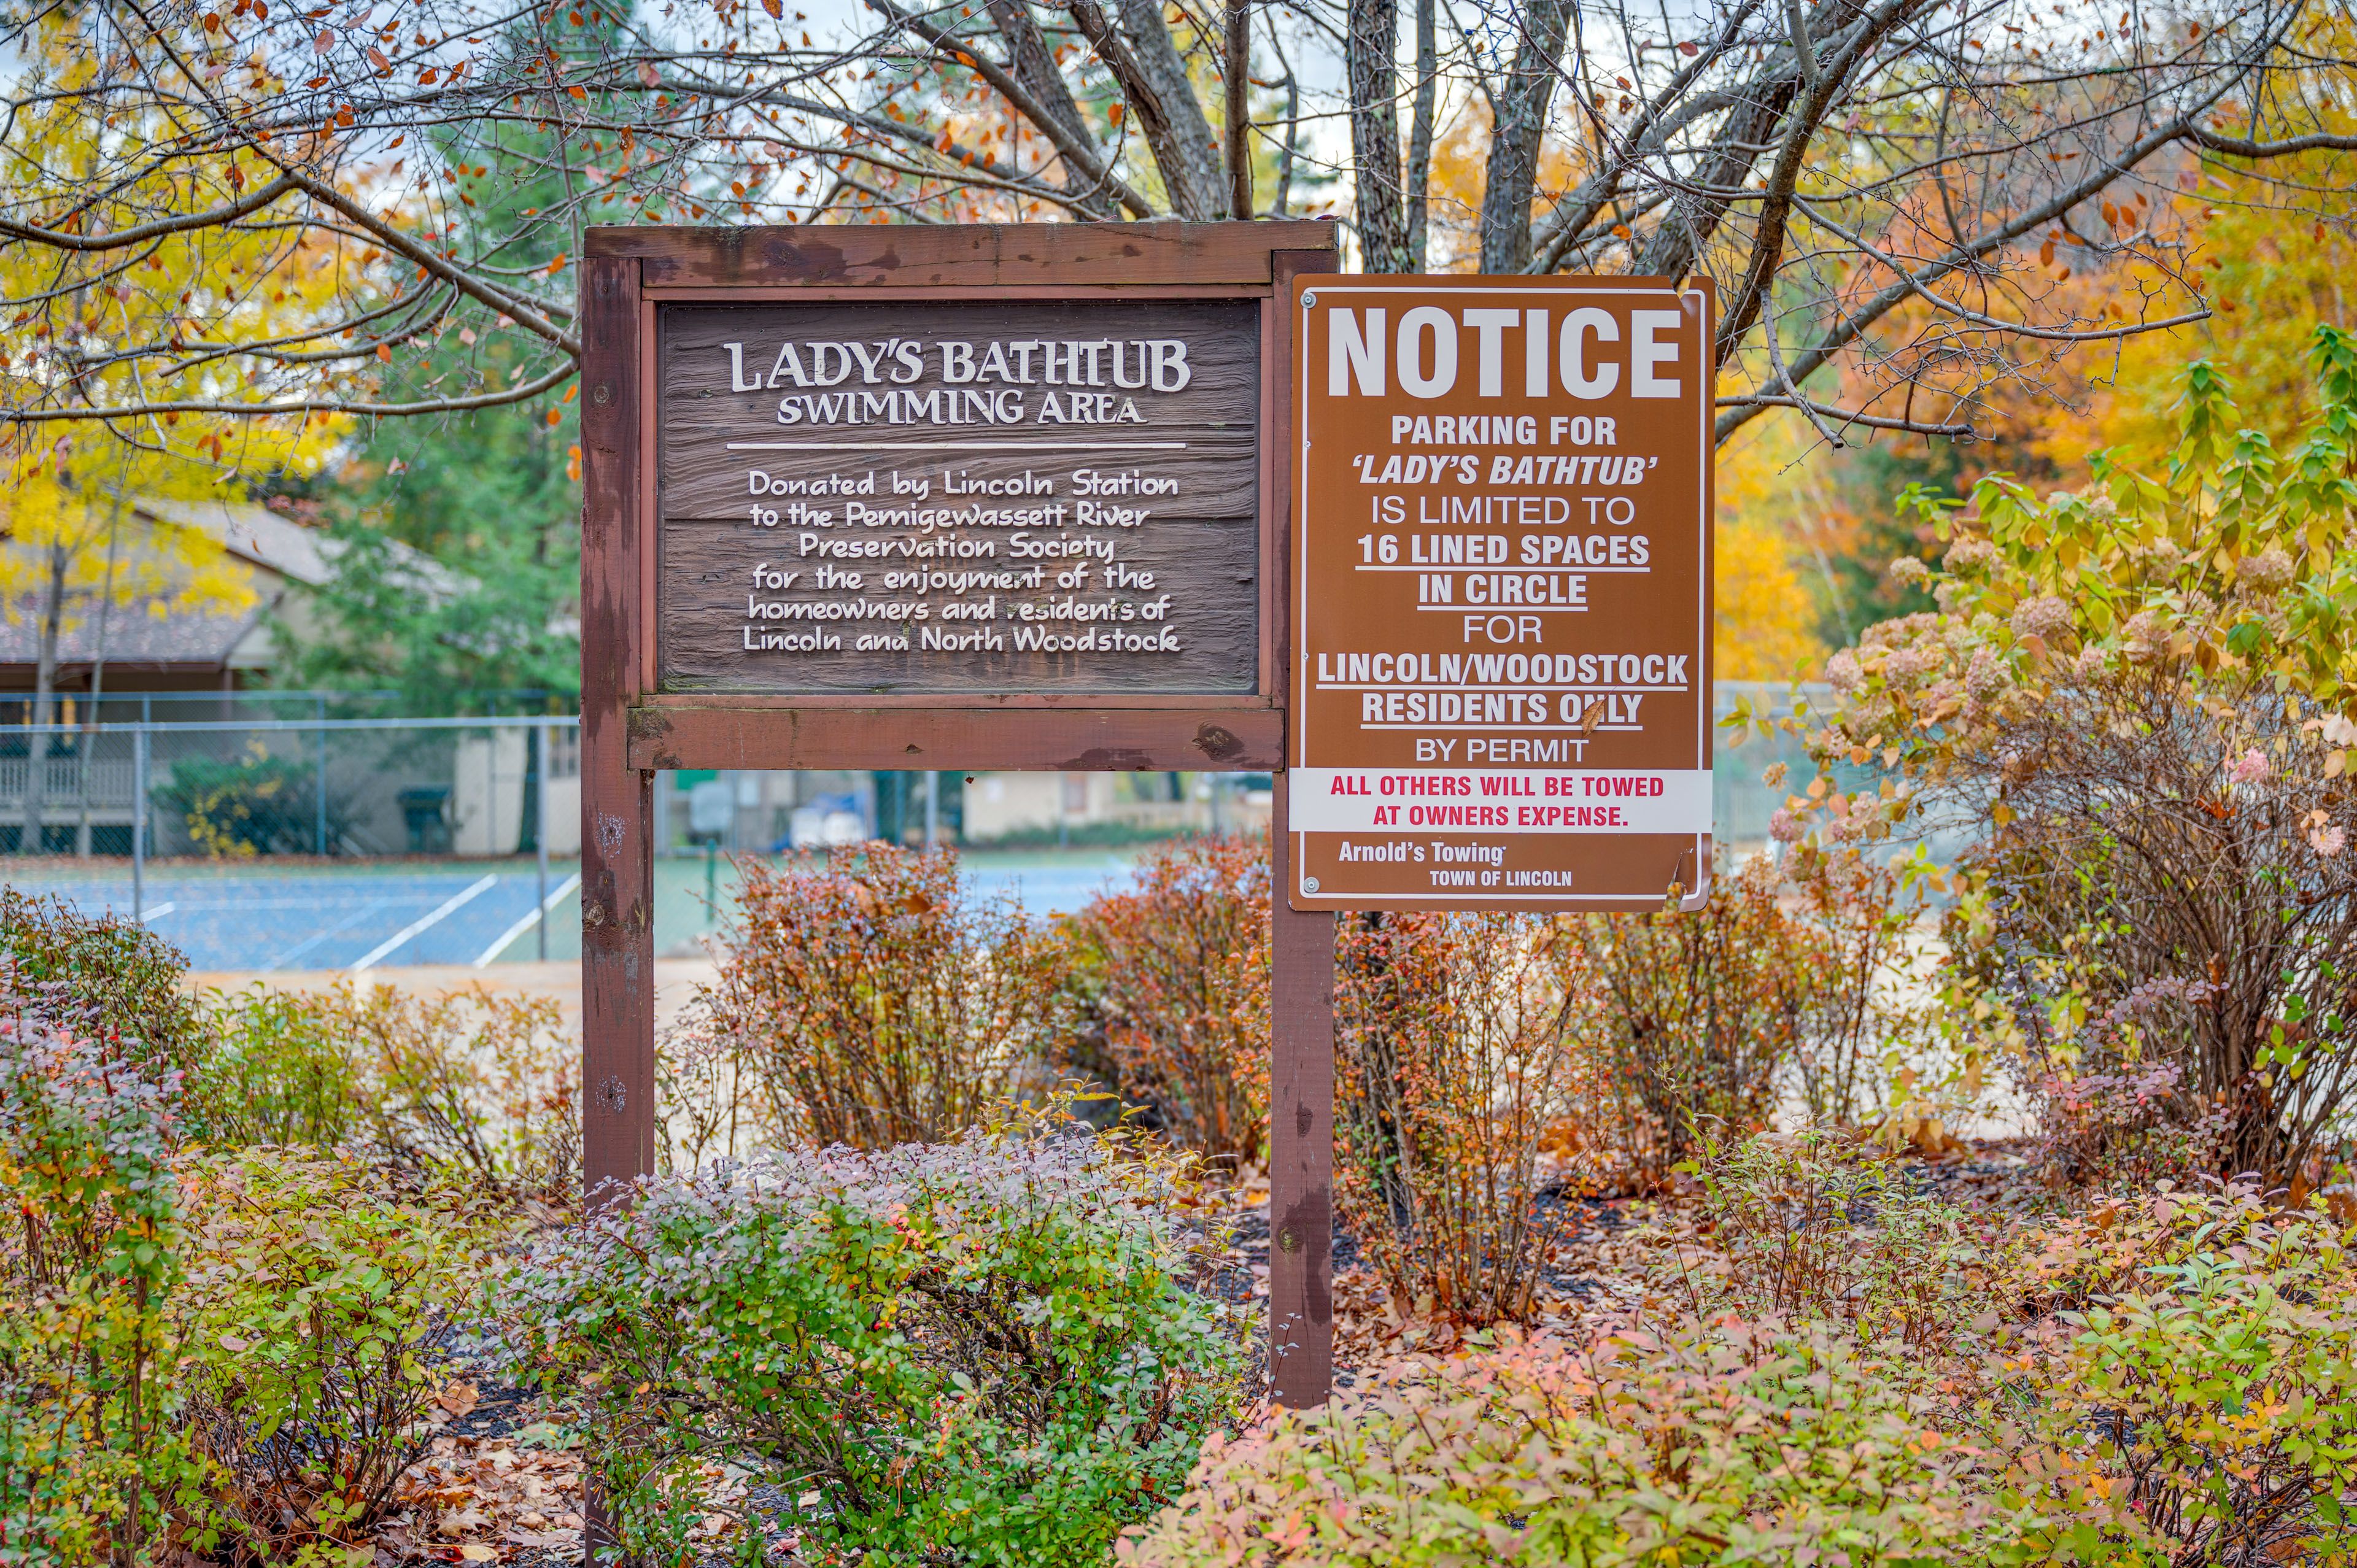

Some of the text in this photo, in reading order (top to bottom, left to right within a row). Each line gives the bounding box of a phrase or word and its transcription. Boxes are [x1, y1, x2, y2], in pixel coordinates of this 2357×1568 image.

[723, 338, 1191, 393] LADY'S BATHTUB
[1328, 306, 1681, 399] NOTICE
[777, 390, 1148, 425] SWIMMING AREA
[1391, 415, 1617, 446] PARKING FOR
[748, 469, 1179, 500] Donated by Lincoln Station
[749, 500, 1150, 534] to the Pemigewassett River
[1372, 496, 1635, 525] IS LIMITED TO
[799, 531, 1114, 563] Preservation Society
[1358, 534, 1650, 565] 16 LINED SPACES
[753, 562, 1155, 594] for the enjoyment of the
[1419, 574, 1587, 604] IN CIRCLE
[748, 595, 929, 621] homeowners
[941, 595, 996, 620] and
[1141, 595, 1171, 621] of
[743, 621, 1181, 652] Lincoln and North Woodstock
[1463, 615, 1542, 643] FOR
[1318, 652, 1689, 686] LINCOLN/WOODSTOCK
[1362, 693, 1546, 724] RESIDENTS
[1416, 739, 1589, 762] BY PERMIT
[1331, 775, 1663, 797] ALL OTHERS WILL BE TOWED
[1373, 805, 1628, 826] AT OWNERS EXPENSE.
[1339, 841, 1503, 867] Arnold’s Towing
[1430, 870, 1572, 887] TOWN OF LINCOLN
